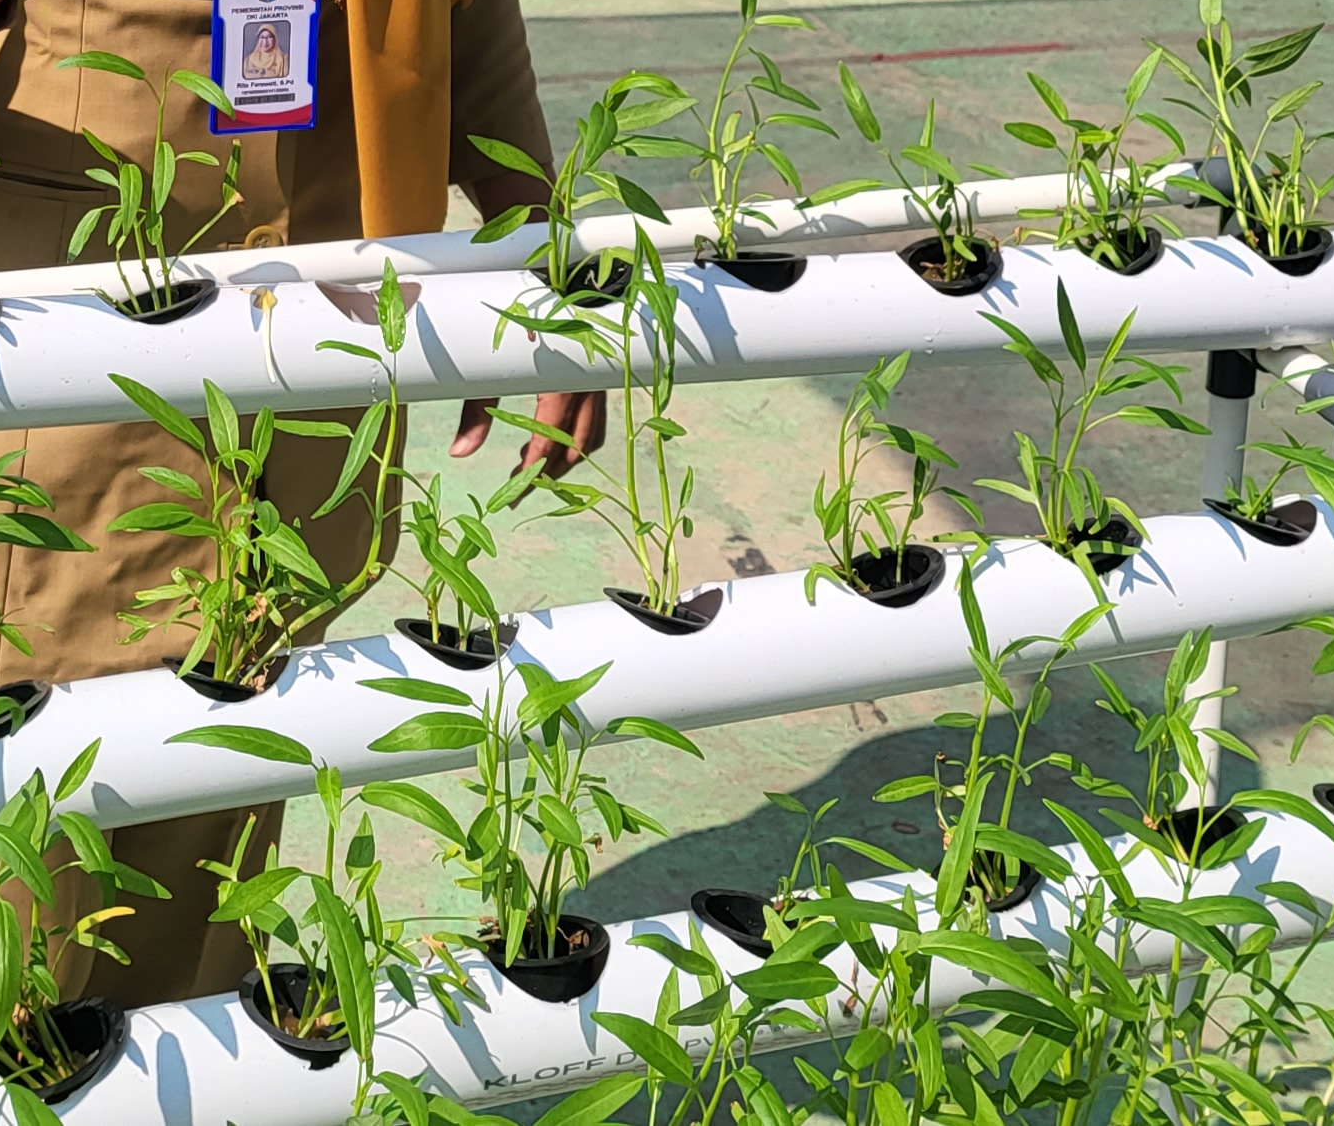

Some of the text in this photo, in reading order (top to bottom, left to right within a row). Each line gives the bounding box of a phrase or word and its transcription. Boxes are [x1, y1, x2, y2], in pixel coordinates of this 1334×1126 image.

[231, 4, 305, 15] PEMERINTAH PROVINSI
[483, 1056, 606, 1091] KLOFF
